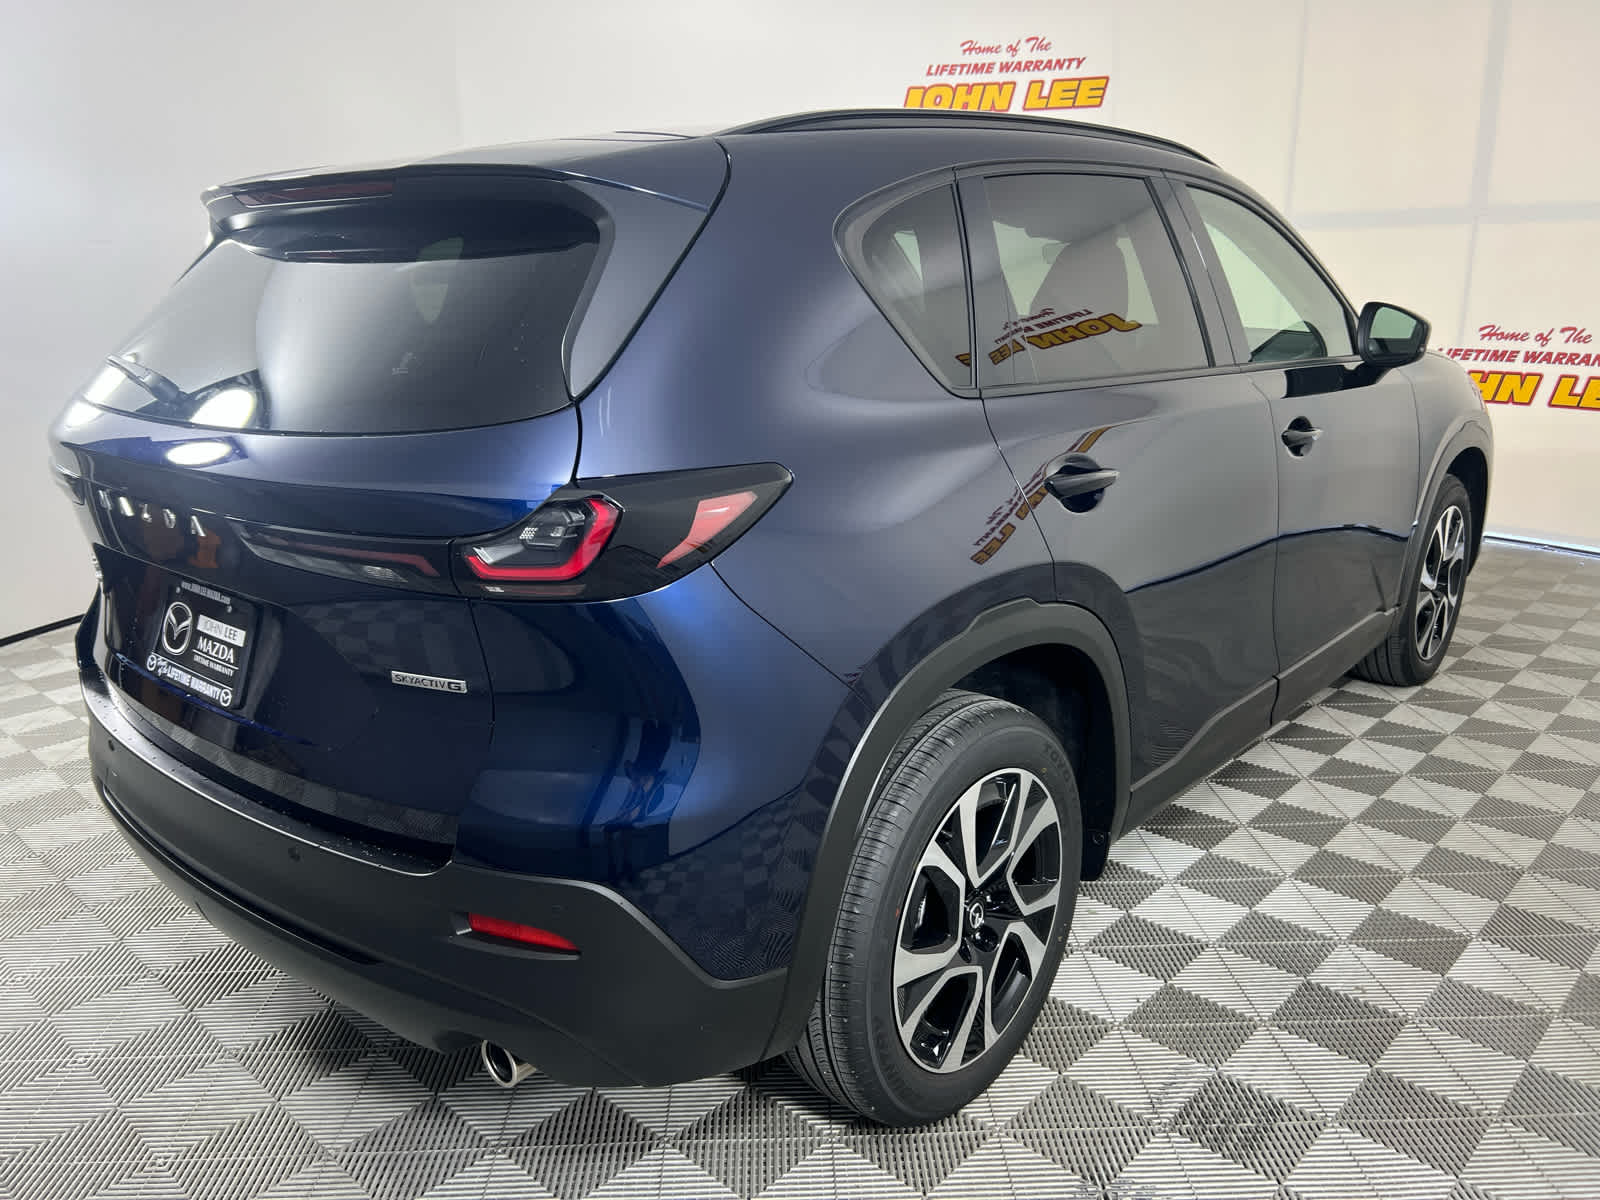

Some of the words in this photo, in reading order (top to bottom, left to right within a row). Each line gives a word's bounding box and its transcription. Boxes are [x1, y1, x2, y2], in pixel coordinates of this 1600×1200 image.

[960, 39, 1001, 56] Home
[1005, 39, 1021, 57] of
[1025, 36, 1052, 52] The
[926, 61, 995, 77] LIFETIME
[999, 56, 1086, 73] WARRANTY
[1022, 76, 1109, 111] LEE
[1478, 324, 1530, 342] Home
[1534, 328, 1554, 347] of
[1559, 326, 1592, 344] The
[1438, 347, 1520, 363] IFETIME
[1522, 350, 1600, 367] WARRAN
[224, 627, 239, 642] LEE
[197, 636, 234, 664] MAZDA
[167, 665, 191, 687] LIFETIME
[190, 676, 222, 701] WARRANTY
[394, 674, 446, 688] SKYACTIV
